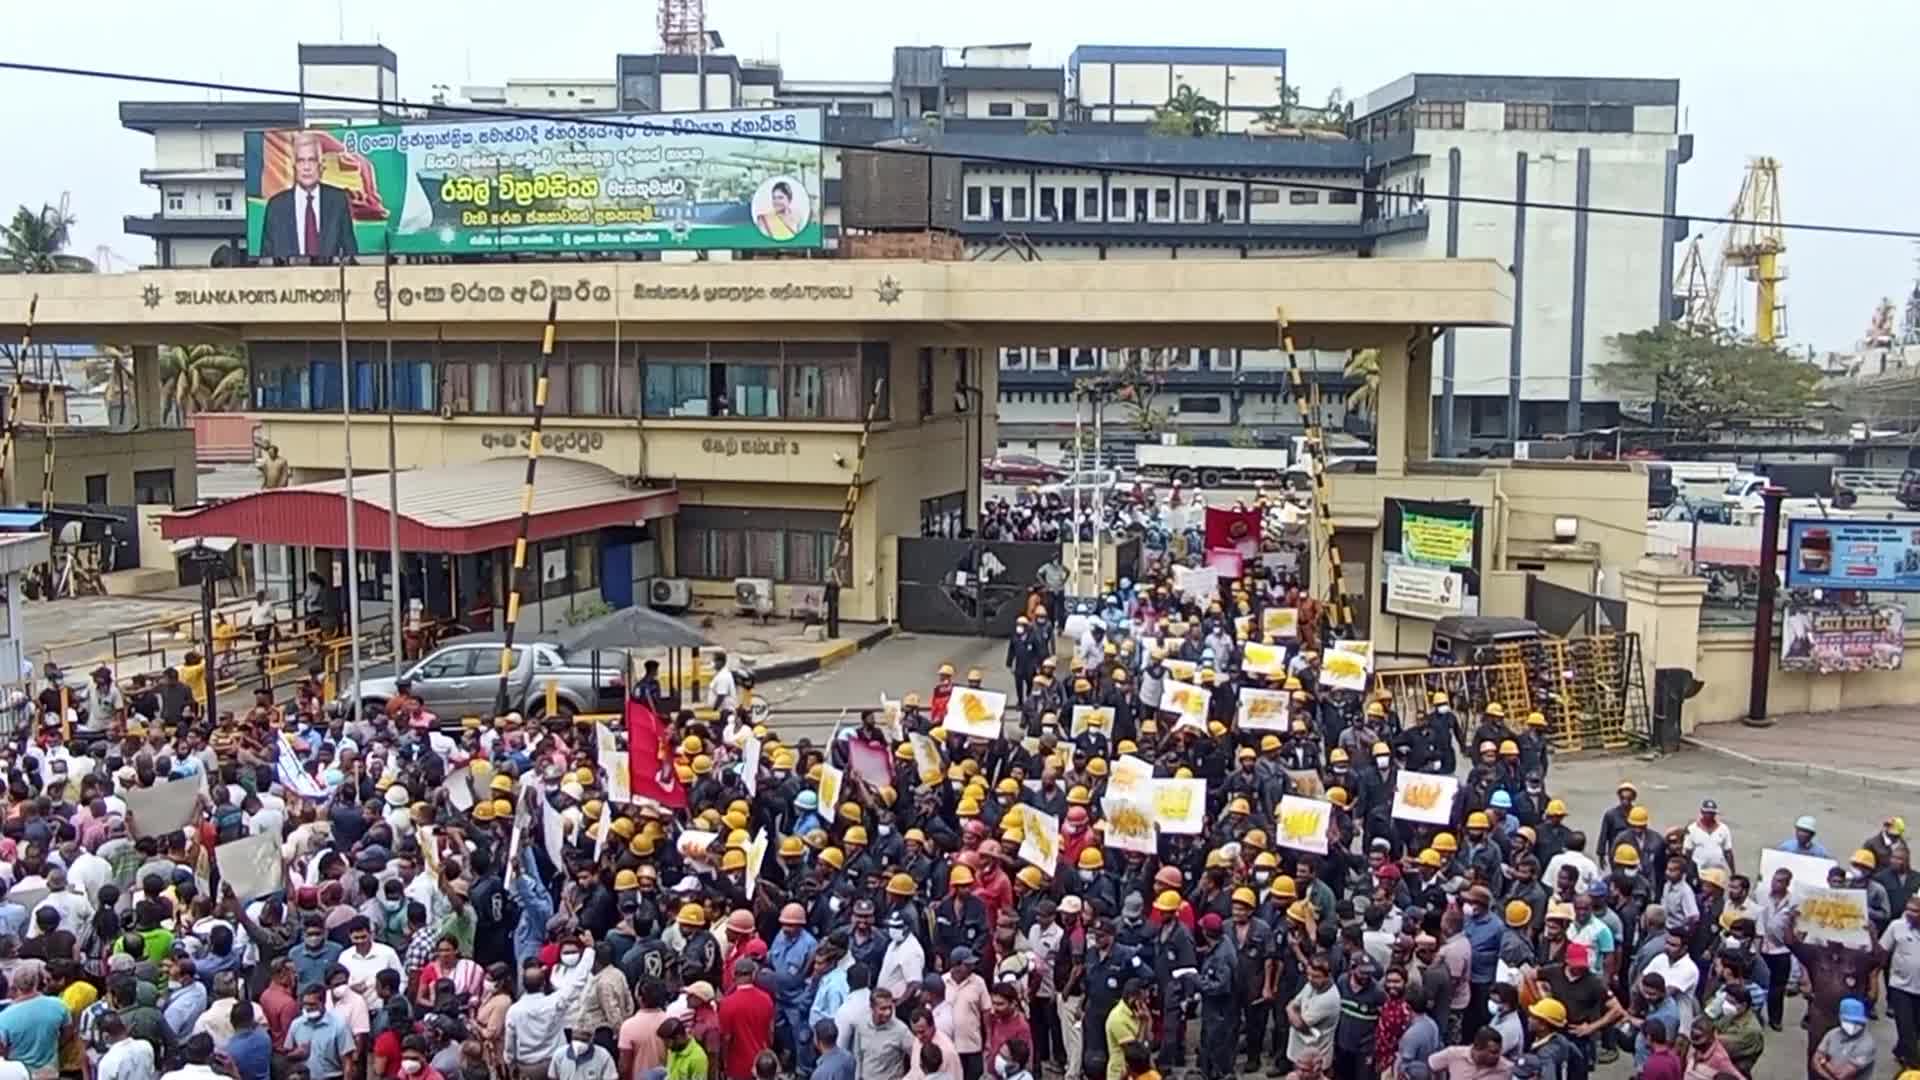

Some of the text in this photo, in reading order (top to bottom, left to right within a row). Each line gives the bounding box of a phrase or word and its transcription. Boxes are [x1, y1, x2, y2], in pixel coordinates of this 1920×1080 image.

[361, 134, 394, 151] ලංකා
[479, 124, 539, 146] සමාජවාදී
[441, 176, 491, 206] රනිල්
[498, 173, 600, 206] වික්‍රමසිංහ
[175, 289, 350, 304] SRI LANKA PORTS AUTHORITY
[398, 286, 446, 306] ලංකා
[450, 282, 505, 303] වරාය
[511, 279, 611, 305] අධිකාරිය
[791, 441, 800, 456] 3
